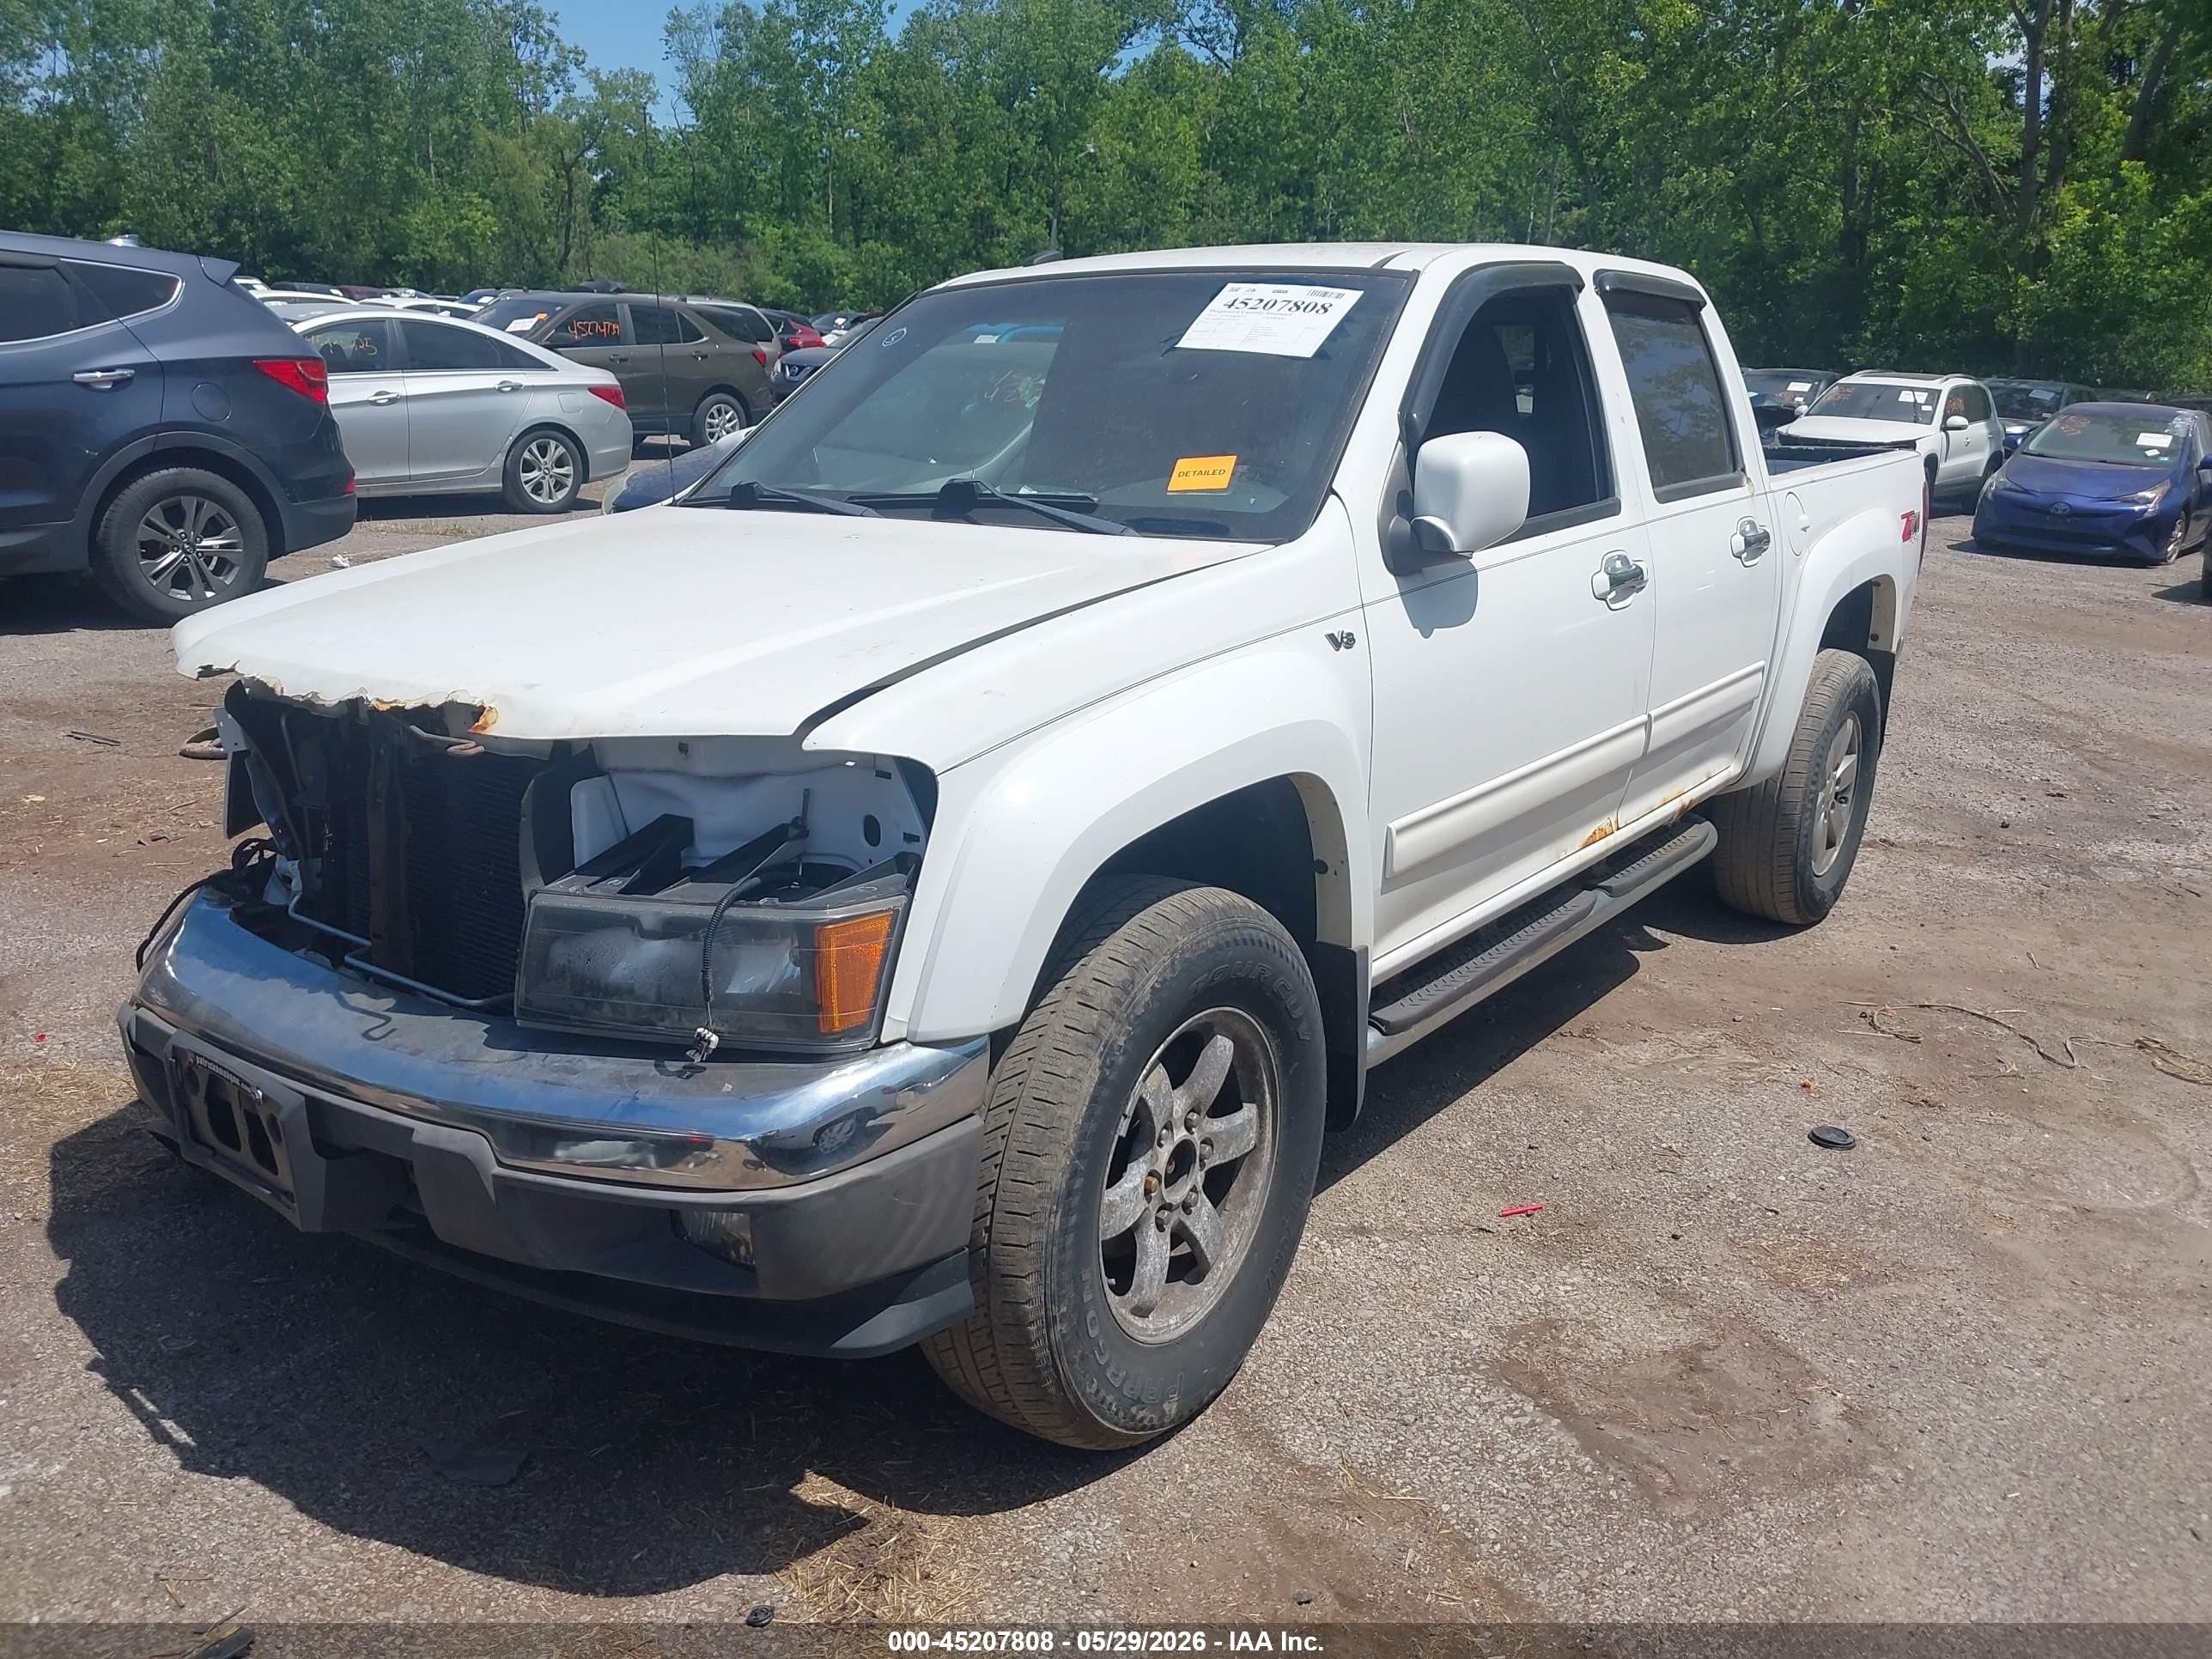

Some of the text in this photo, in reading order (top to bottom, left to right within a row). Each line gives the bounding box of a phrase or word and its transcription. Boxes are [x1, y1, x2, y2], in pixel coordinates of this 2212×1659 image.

[1223, 296, 1334, 315] 45207808
[1178, 469, 1226, 477] DETAILED
[1325, 630, 1356, 652] V8
